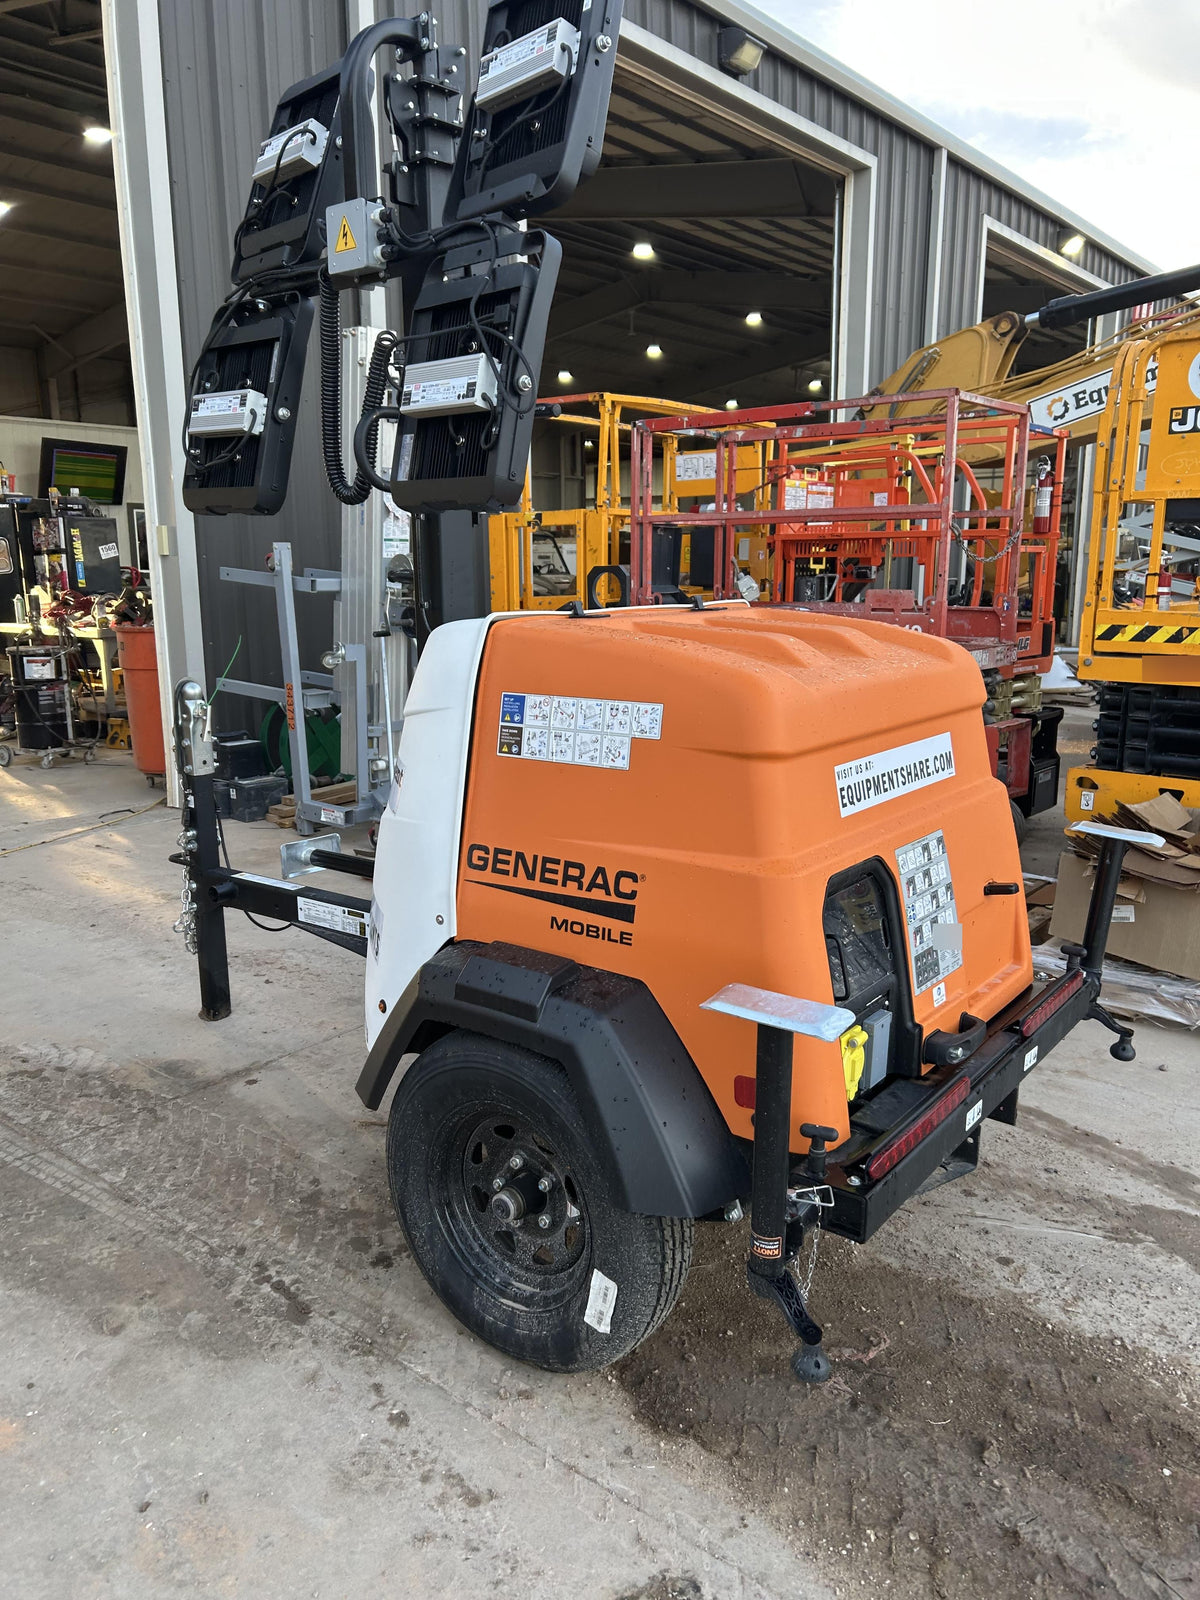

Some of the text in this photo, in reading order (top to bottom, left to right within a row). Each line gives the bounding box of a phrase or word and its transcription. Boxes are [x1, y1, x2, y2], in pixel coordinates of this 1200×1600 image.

[836, 761, 874, 781] VISIT US AT:
[839, 751, 953, 808] EQUIPMENTSHARE.COM
[466, 843, 638, 900] GENERAC
[550, 916, 633, 946] MOBILE
